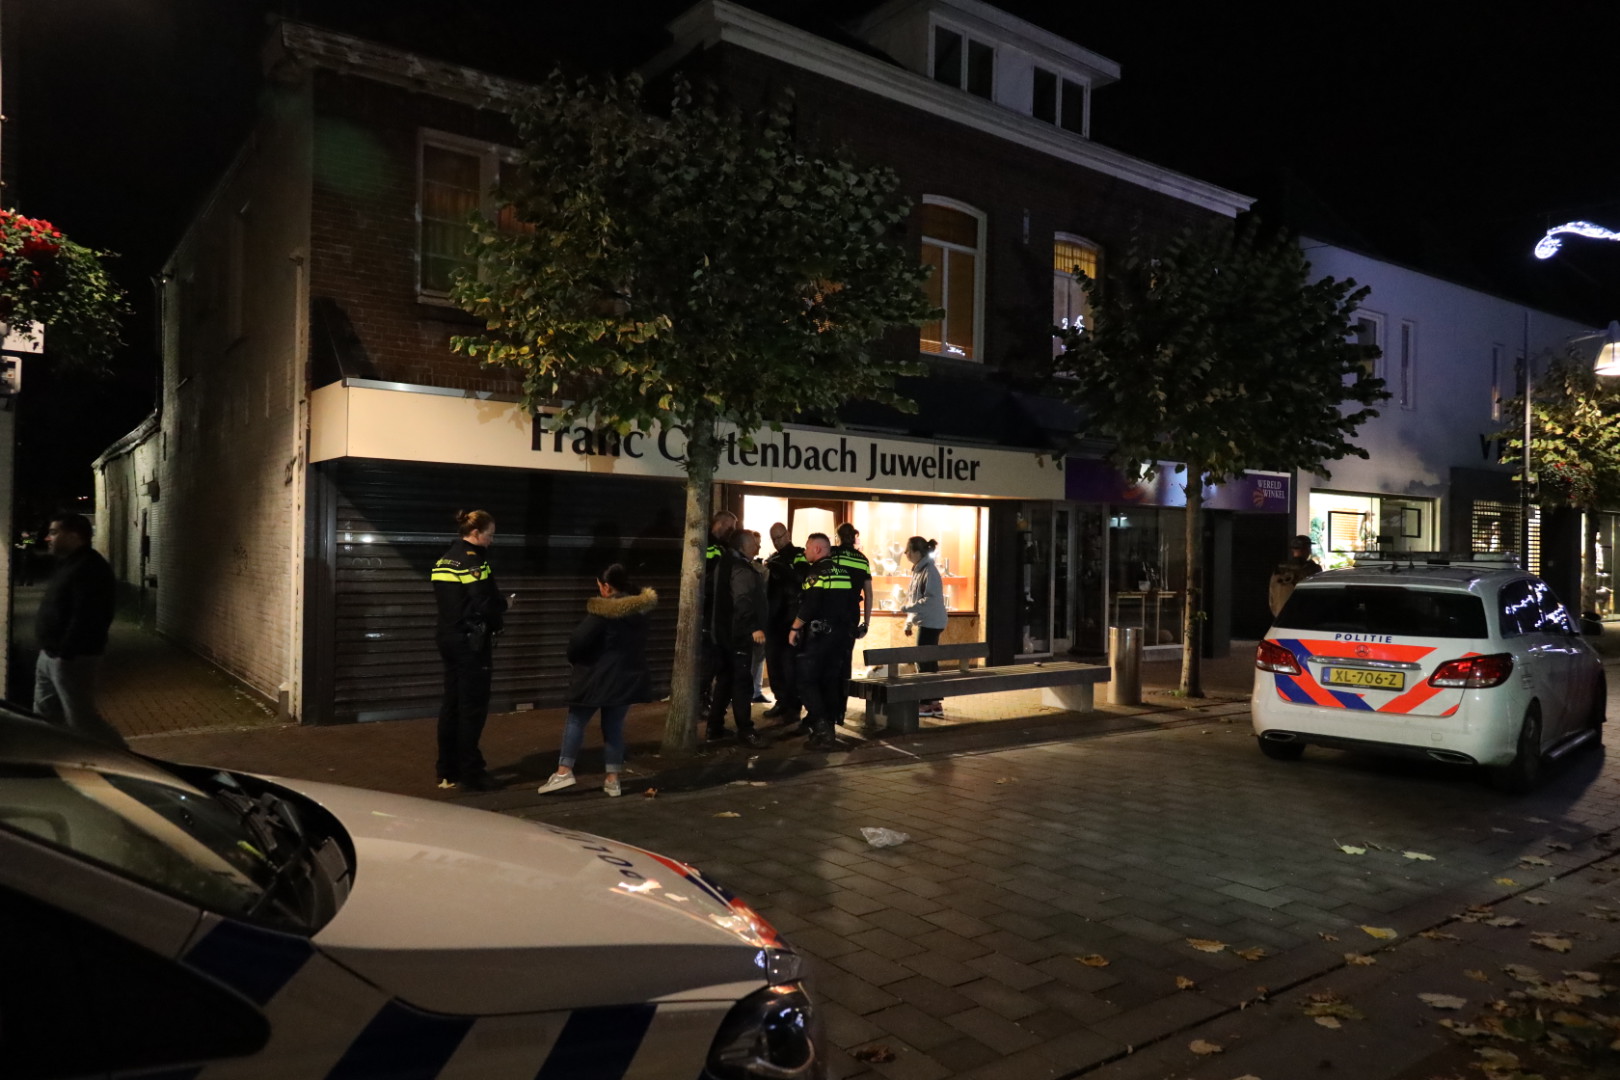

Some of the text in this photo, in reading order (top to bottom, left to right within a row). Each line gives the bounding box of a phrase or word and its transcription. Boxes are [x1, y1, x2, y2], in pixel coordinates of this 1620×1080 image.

[531, 413, 981, 481] Franc Ctenbach Juwelier
[1257, 479, 1282, 490] WERELD
[1262, 489, 1286, 500] WINKEL
[1335, 633, 1393, 644] POLITIE
[1334, 669, 1397, 687] XL-706-Z
